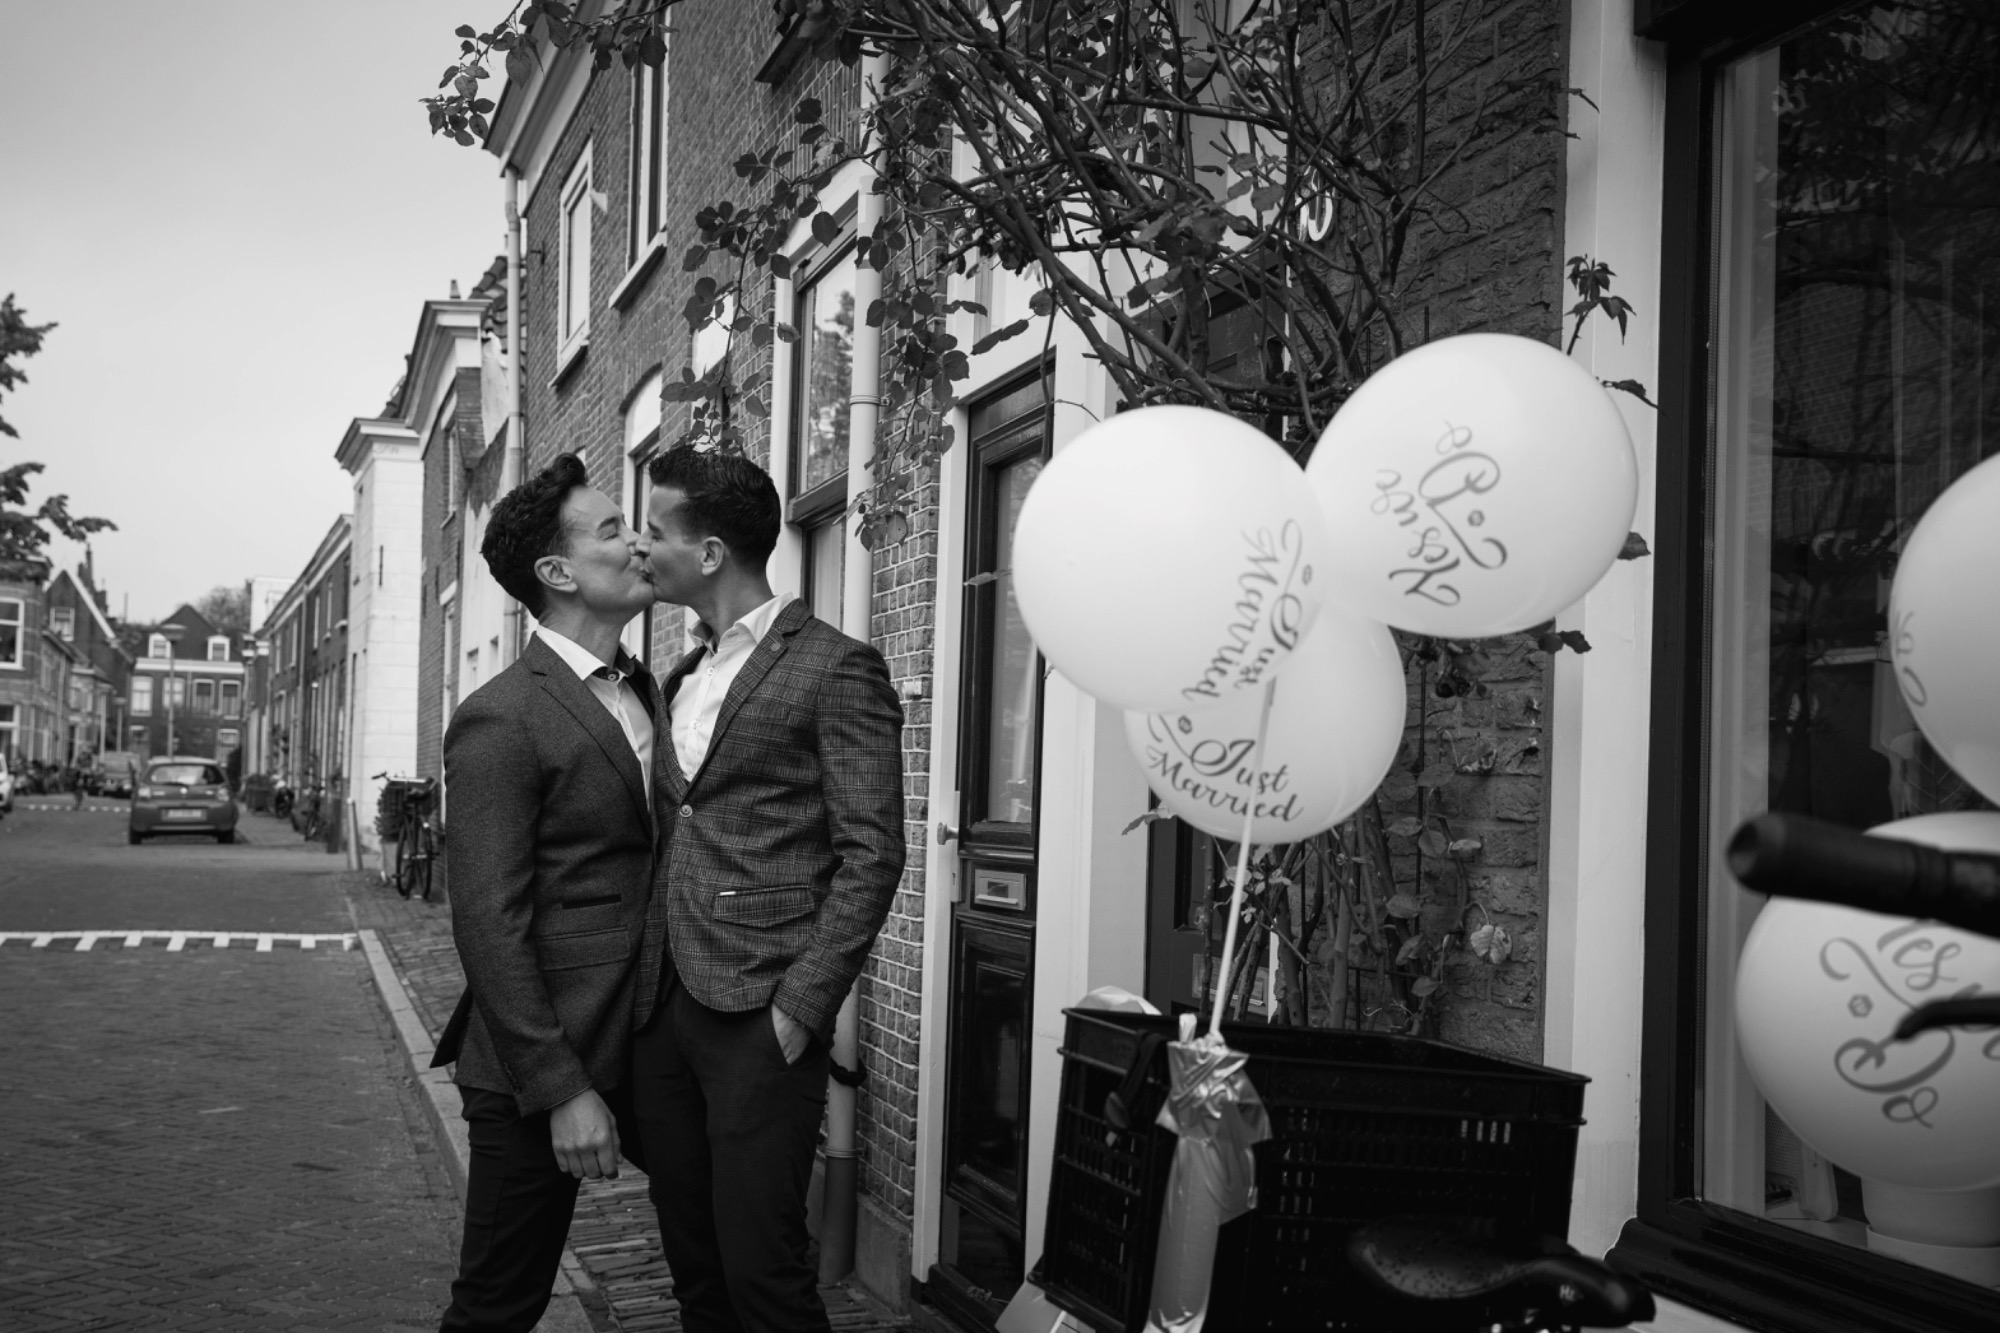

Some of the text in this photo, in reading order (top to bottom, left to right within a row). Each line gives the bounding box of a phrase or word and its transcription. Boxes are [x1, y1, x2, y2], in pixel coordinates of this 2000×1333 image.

[1370, 468, 1461, 607] Yes we
[1419, 420, 1508, 570] Do
[1182, 528, 1280, 702] Married
[1234, 518, 1303, 690] Just
[1146, 745, 1304, 822] Married
[1156, 714, 1288, 795] Just
